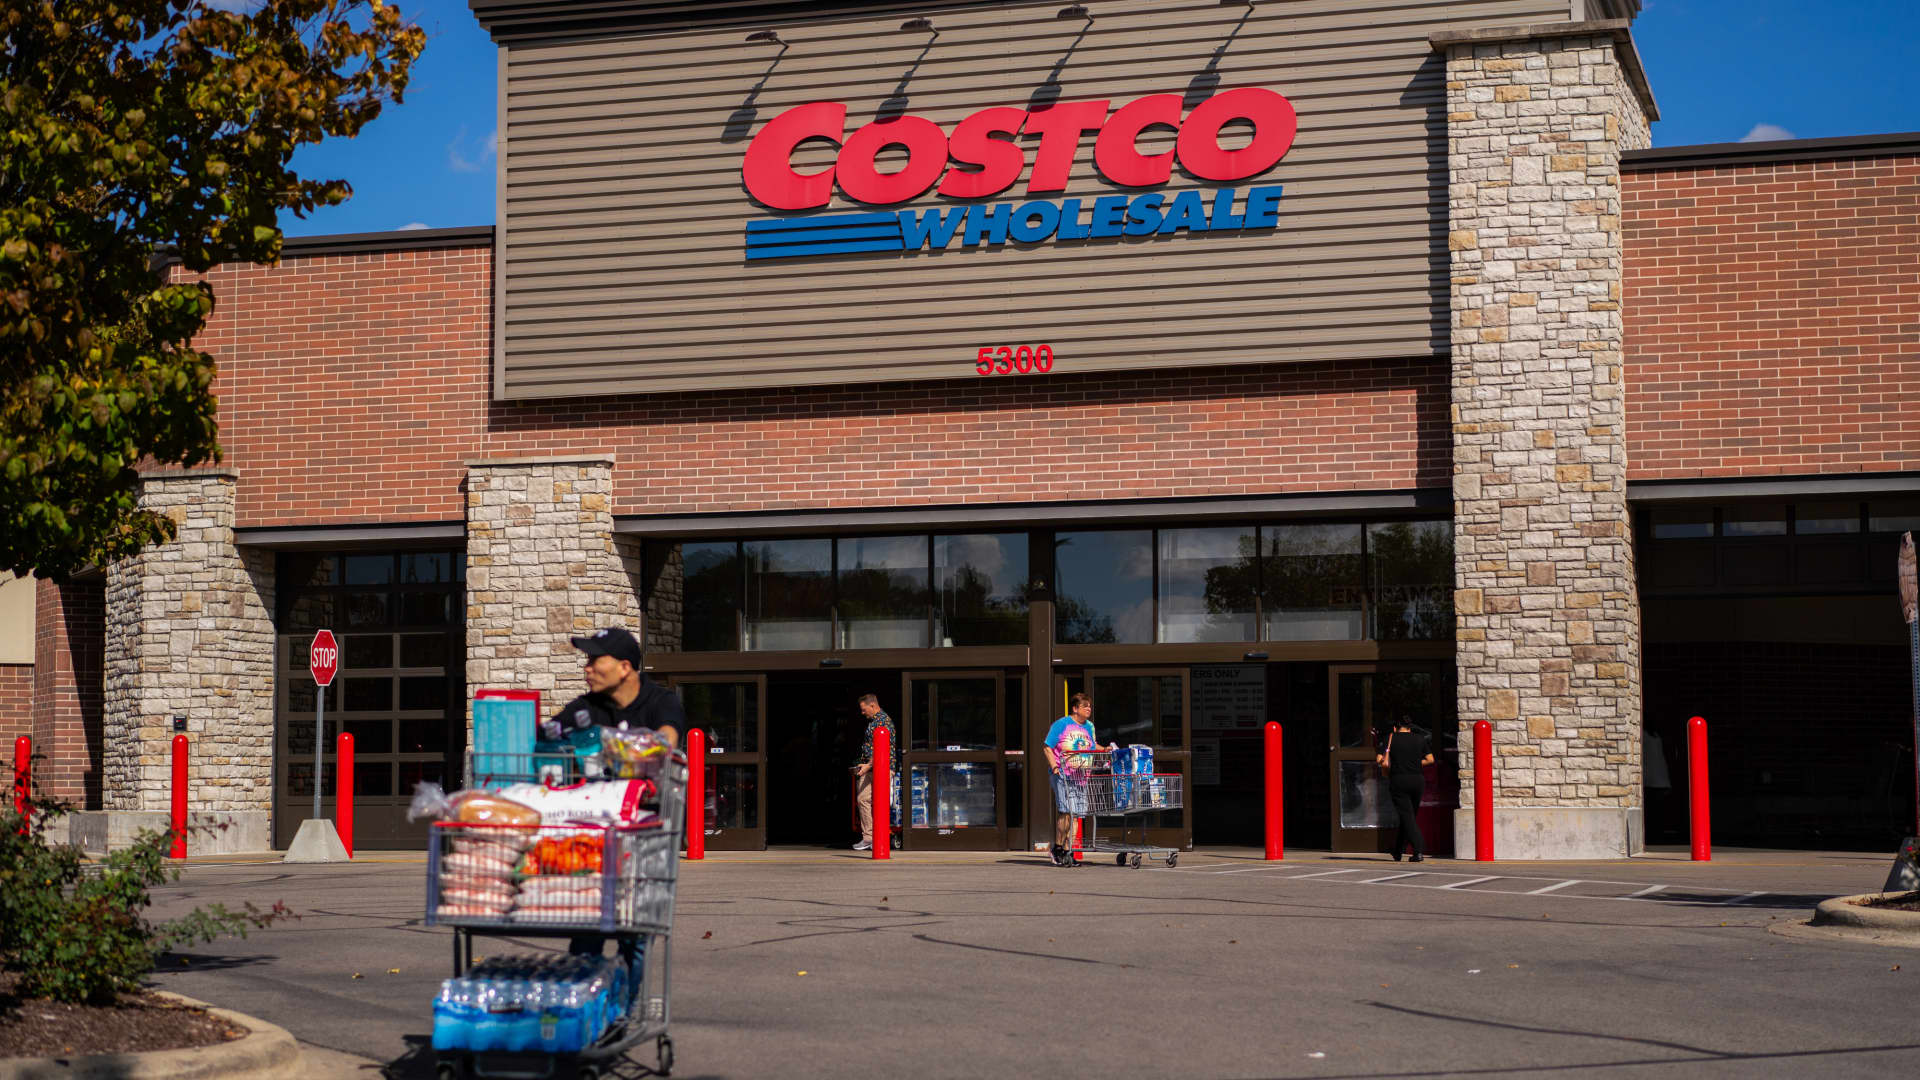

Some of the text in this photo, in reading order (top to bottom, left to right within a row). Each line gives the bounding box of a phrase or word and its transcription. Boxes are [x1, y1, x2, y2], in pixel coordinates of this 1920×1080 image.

[742, 87, 1297, 210] COSTCO
[901, 185, 1283, 250] WHOLESALE
[976, 345, 1053, 375] 5300
[313, 647, 336, 668] STOP
[1214, 669, 1241, 678] ONLY
